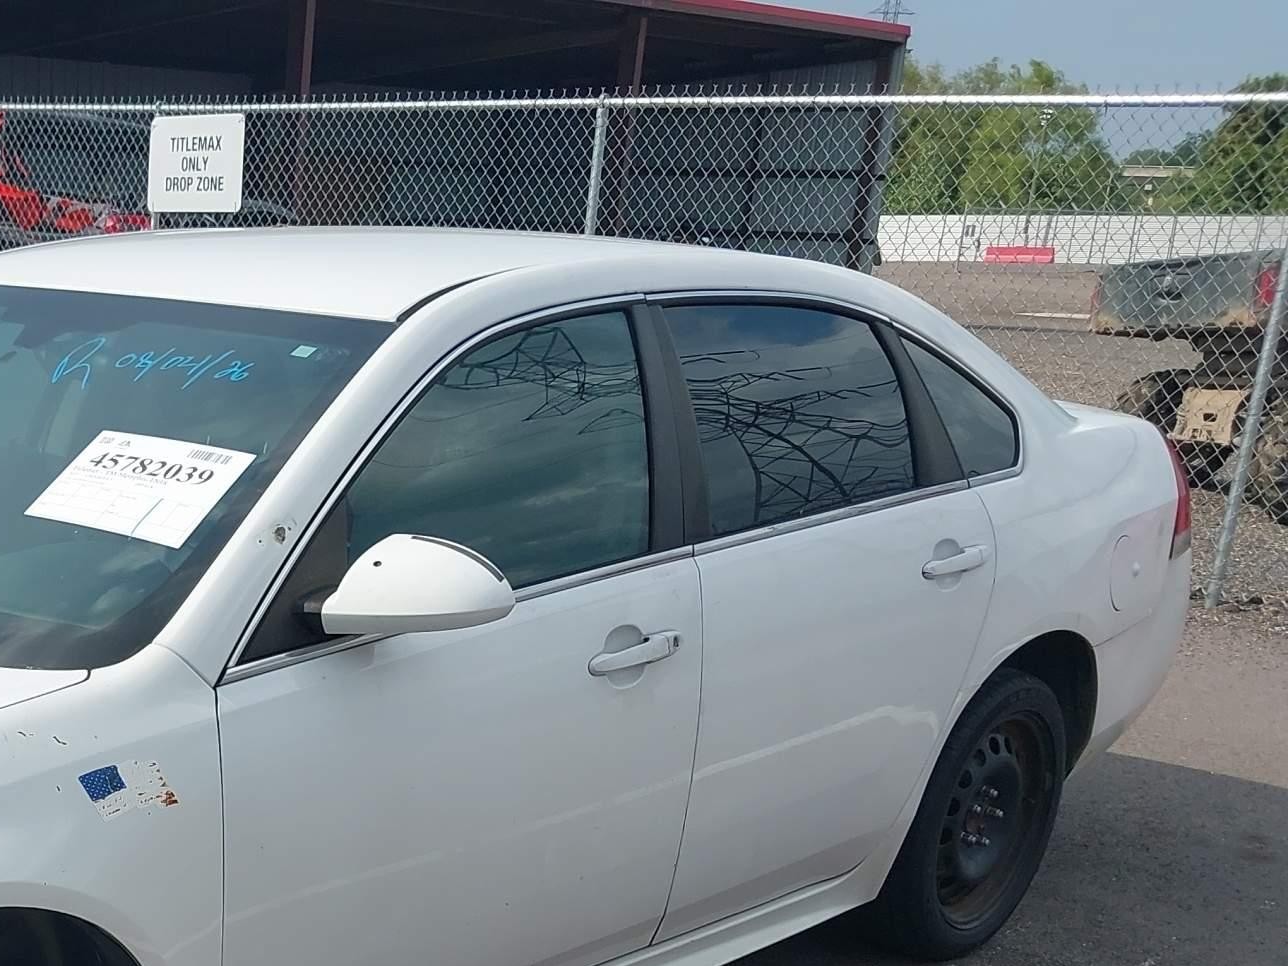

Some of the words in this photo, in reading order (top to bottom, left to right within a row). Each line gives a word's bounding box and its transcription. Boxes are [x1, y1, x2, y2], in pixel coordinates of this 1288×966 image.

[170, 135, 223, 153] TITLEMAX
[181, 156, 209, 172] ONLY
[165, 177, 193, 192] DROP
[196, 176, 225, 192] ZONE
[89, 451, 214, 485] 45782039
